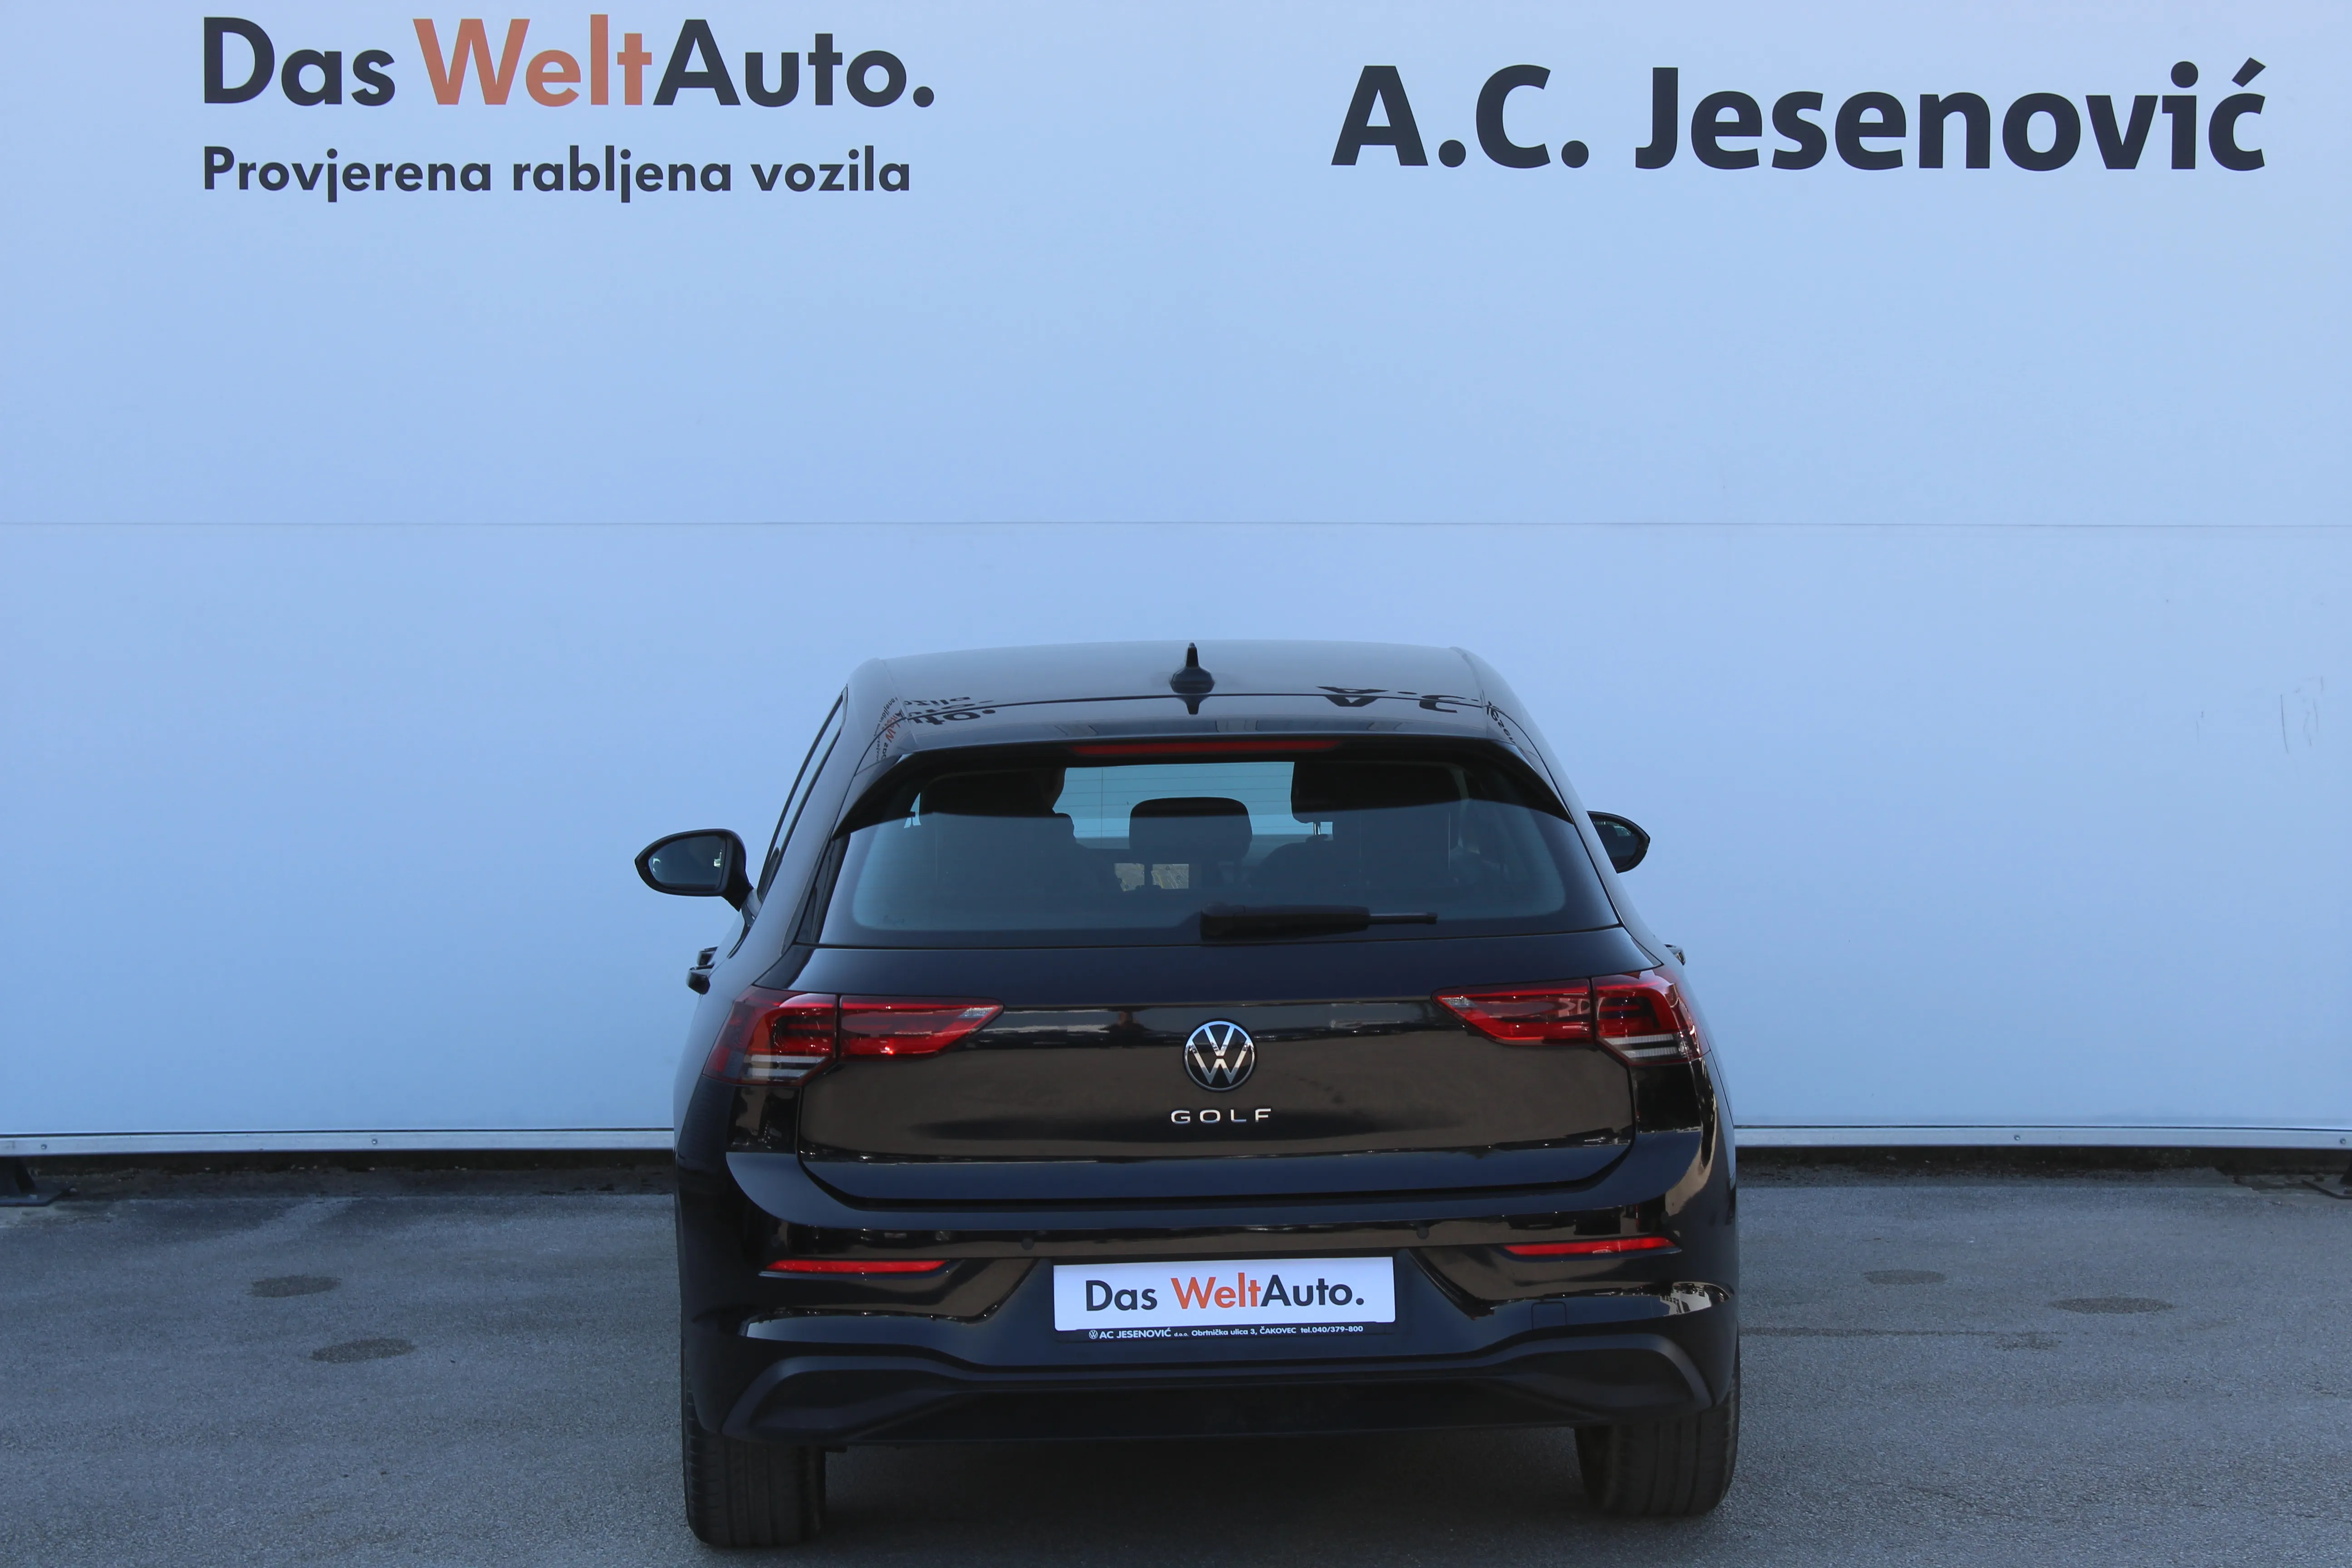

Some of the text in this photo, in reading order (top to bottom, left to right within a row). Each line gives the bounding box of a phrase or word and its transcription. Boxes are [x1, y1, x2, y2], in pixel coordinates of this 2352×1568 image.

[204, 14, 934, 108] Das WeltAuto.
[1331, 57, 2267, 172] A.C. Jesenović
[204, 144, 910, 203] Provjerena rabljena vozila
[1171, 1108, 1272, 1124] GOLF
[1085, 1272, 1365, 1312] Das WeltAuto.
[1099, 1331, 1114, 1339] AC
[1116, 1327, 1171, 1339] JESENOVIĆ
[1259, 1326, 1297, 1335] ČAKOVEC
[1300, 1325, 1364, 1333] tel.040/379-800
